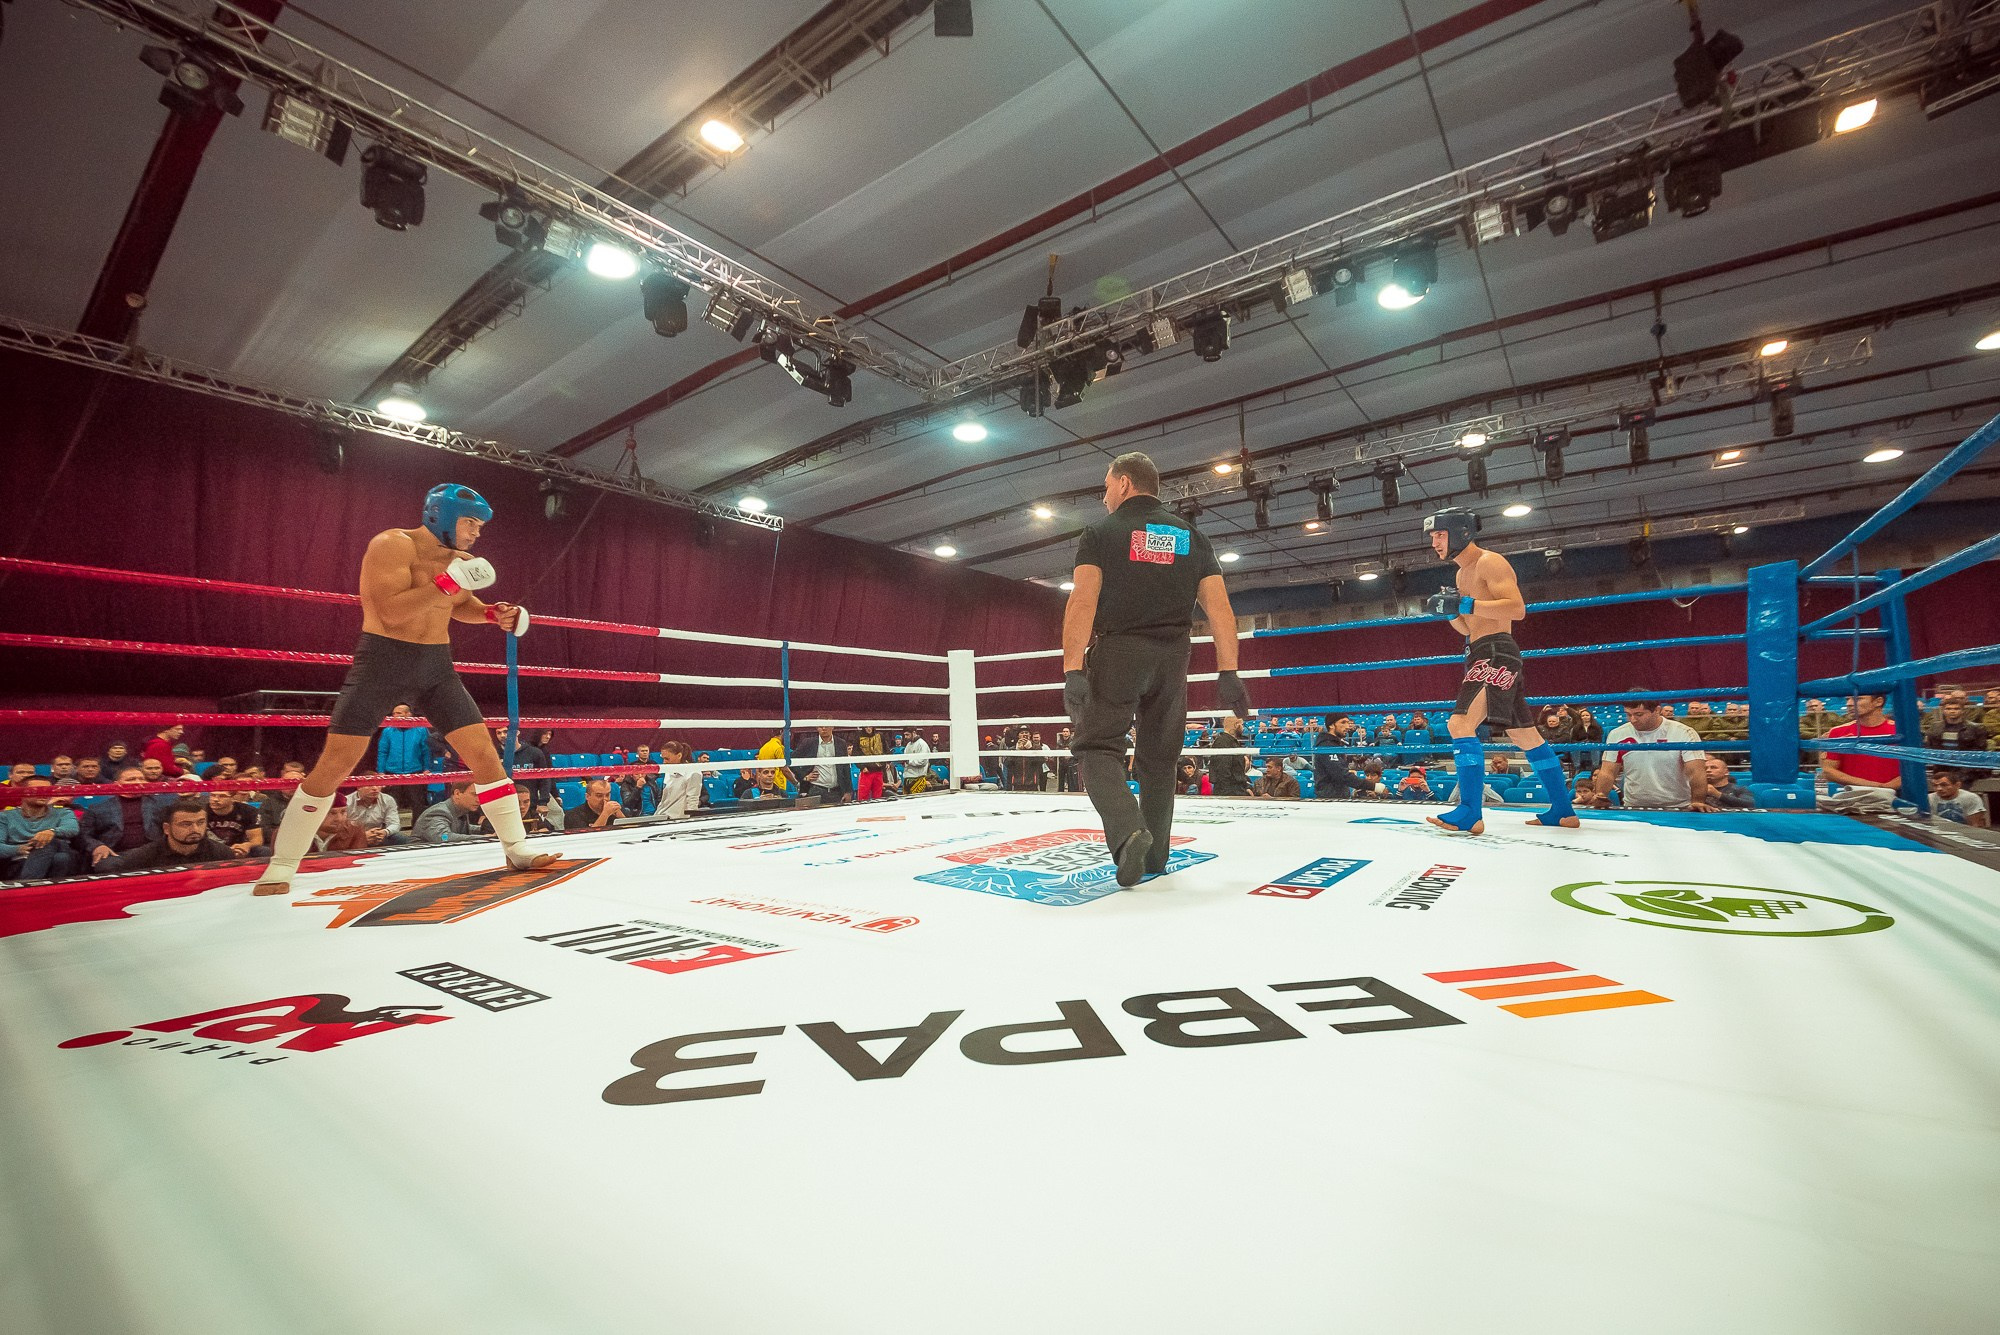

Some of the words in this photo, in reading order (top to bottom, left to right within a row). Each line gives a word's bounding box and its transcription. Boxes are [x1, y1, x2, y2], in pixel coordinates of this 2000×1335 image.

[1287, 860, 1358, 884] РОССИЯ
[1385, 863, 1467, 911] ALLBOXING
[1259, 886, 1312, 896] 2
[690, 896, 852, 926] ЧЕМПИОНАТ
[523, 924, 717, 962] АГАТ
[406, 966, 541, 1008] ENERGY
[122, 1036, 291, 1066] РАДИО
[601, 976, 1468, 1107] ЕВРАЗ
